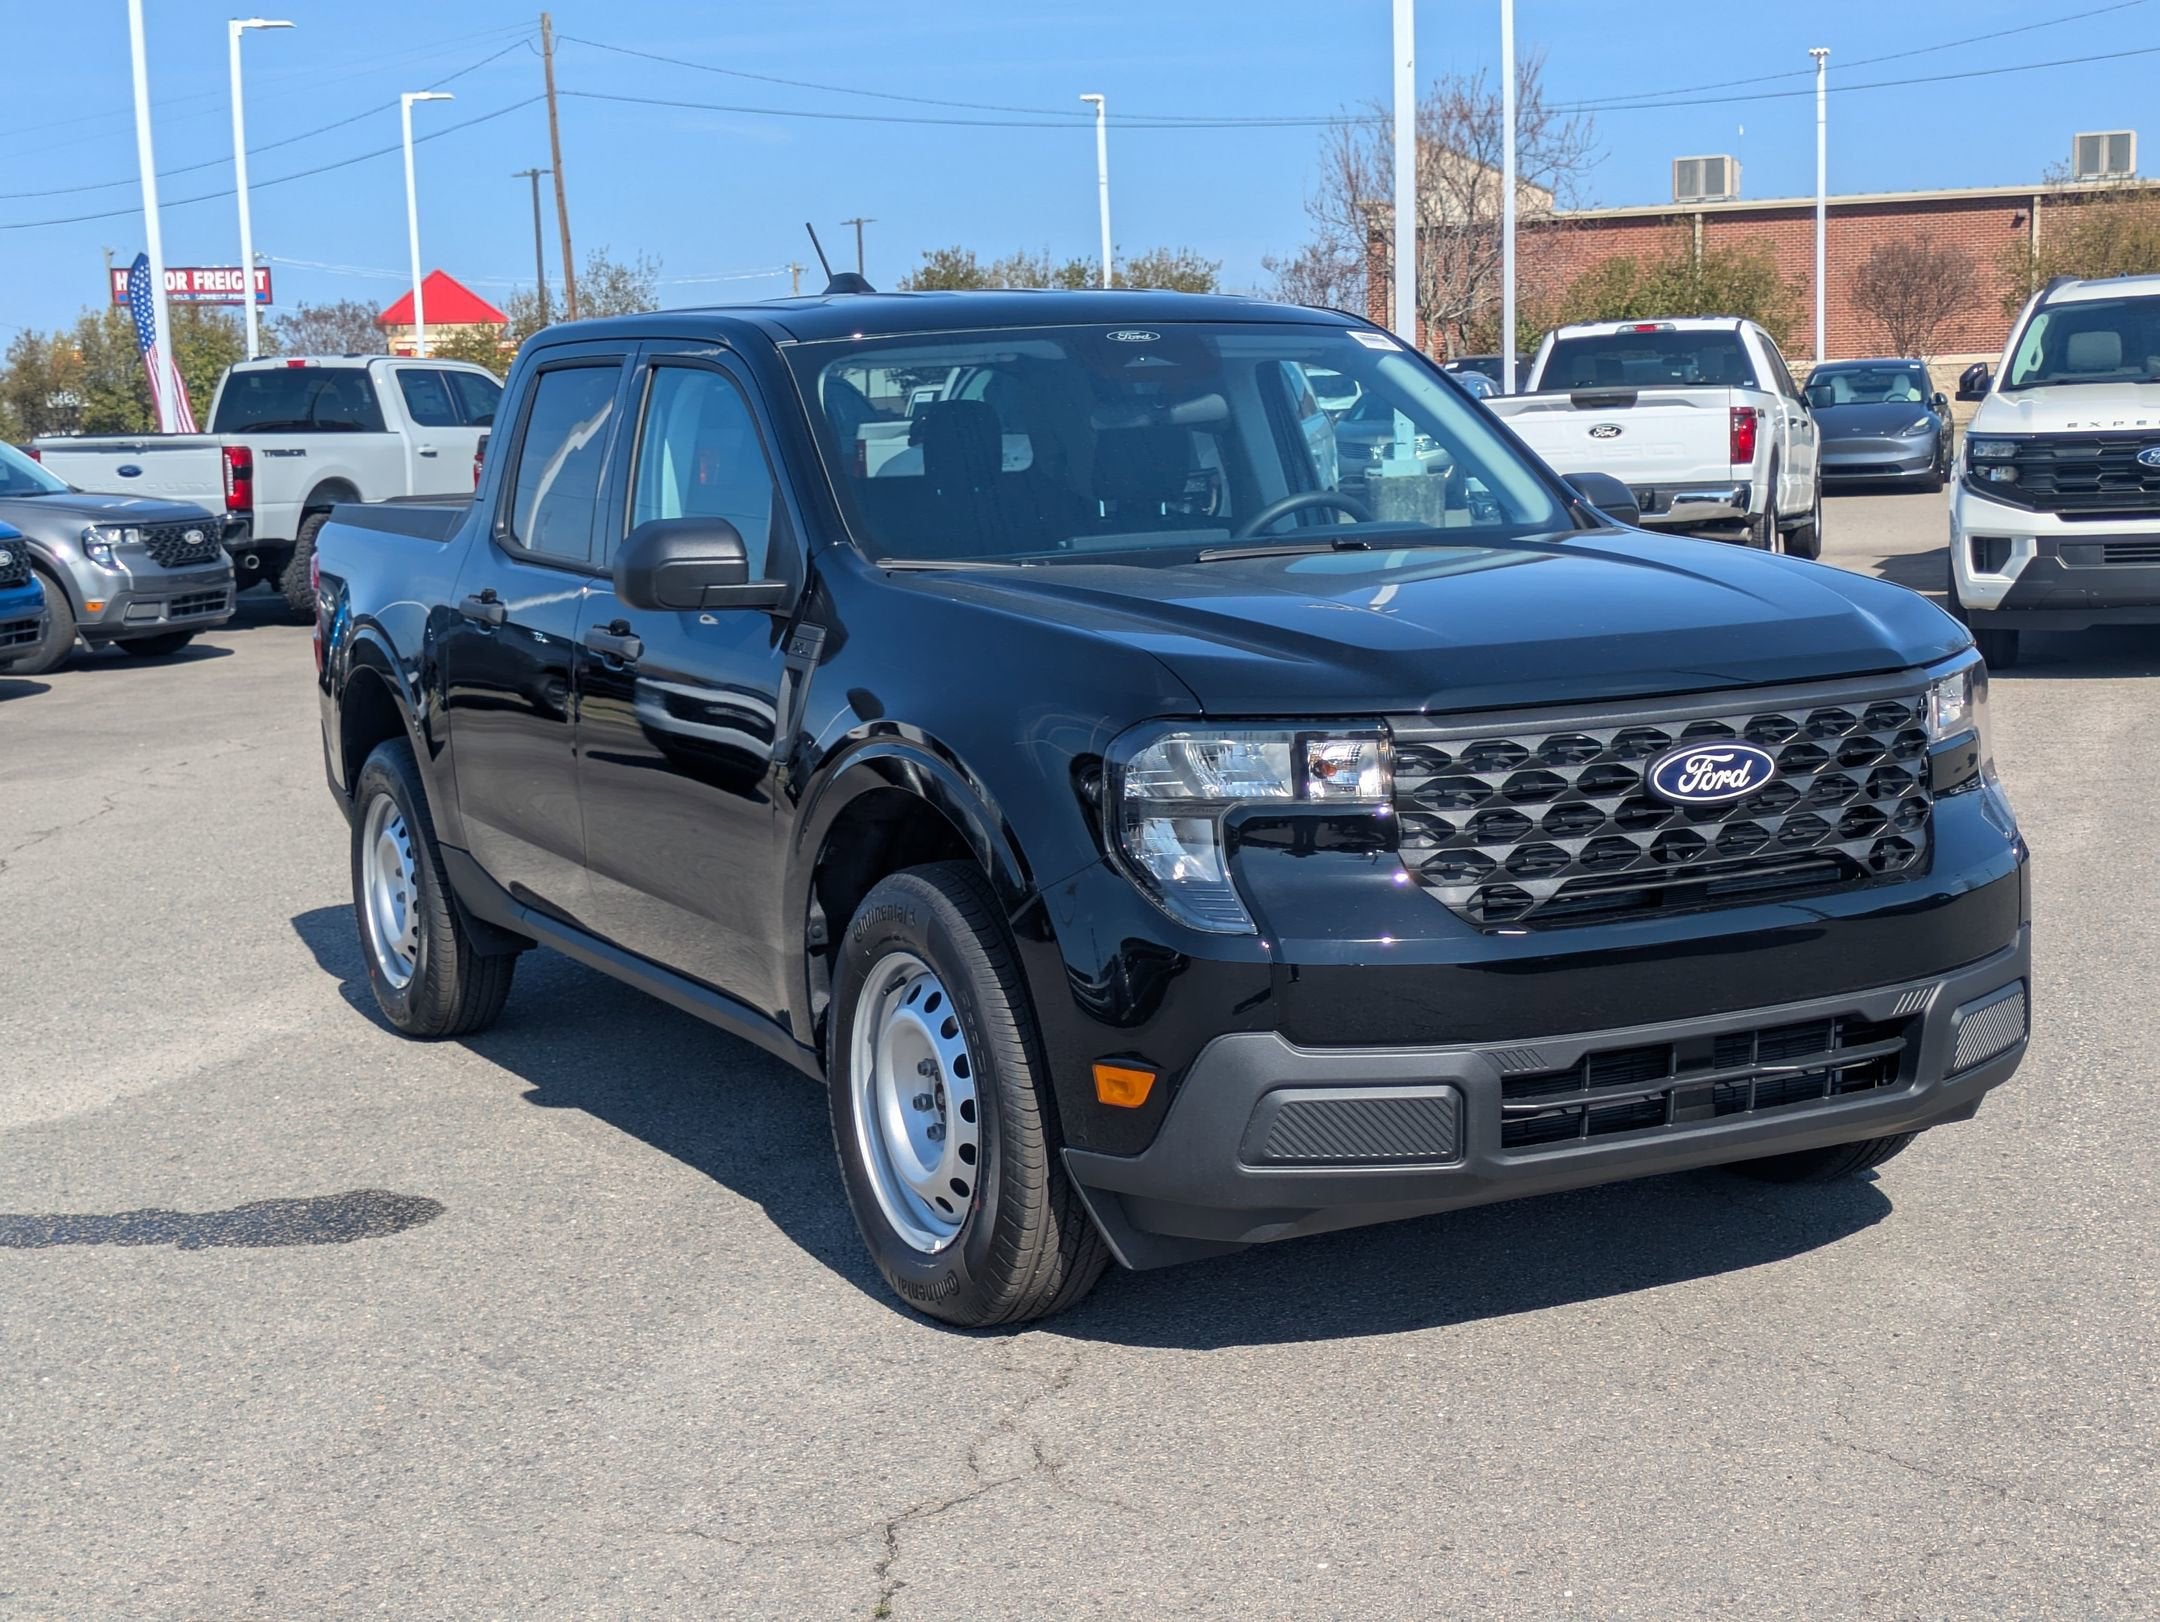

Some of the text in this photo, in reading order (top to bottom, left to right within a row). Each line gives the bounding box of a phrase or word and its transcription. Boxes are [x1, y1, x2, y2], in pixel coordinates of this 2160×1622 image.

[115, 270, 266, 291] HOR FREIGT
[1116, 331, 1152, 340] Ford
[2066, 420, 2160, 429] EXPE
[1593, 427, 1617, 437] Ford
[1678, 753, 1752, 793] Ford
